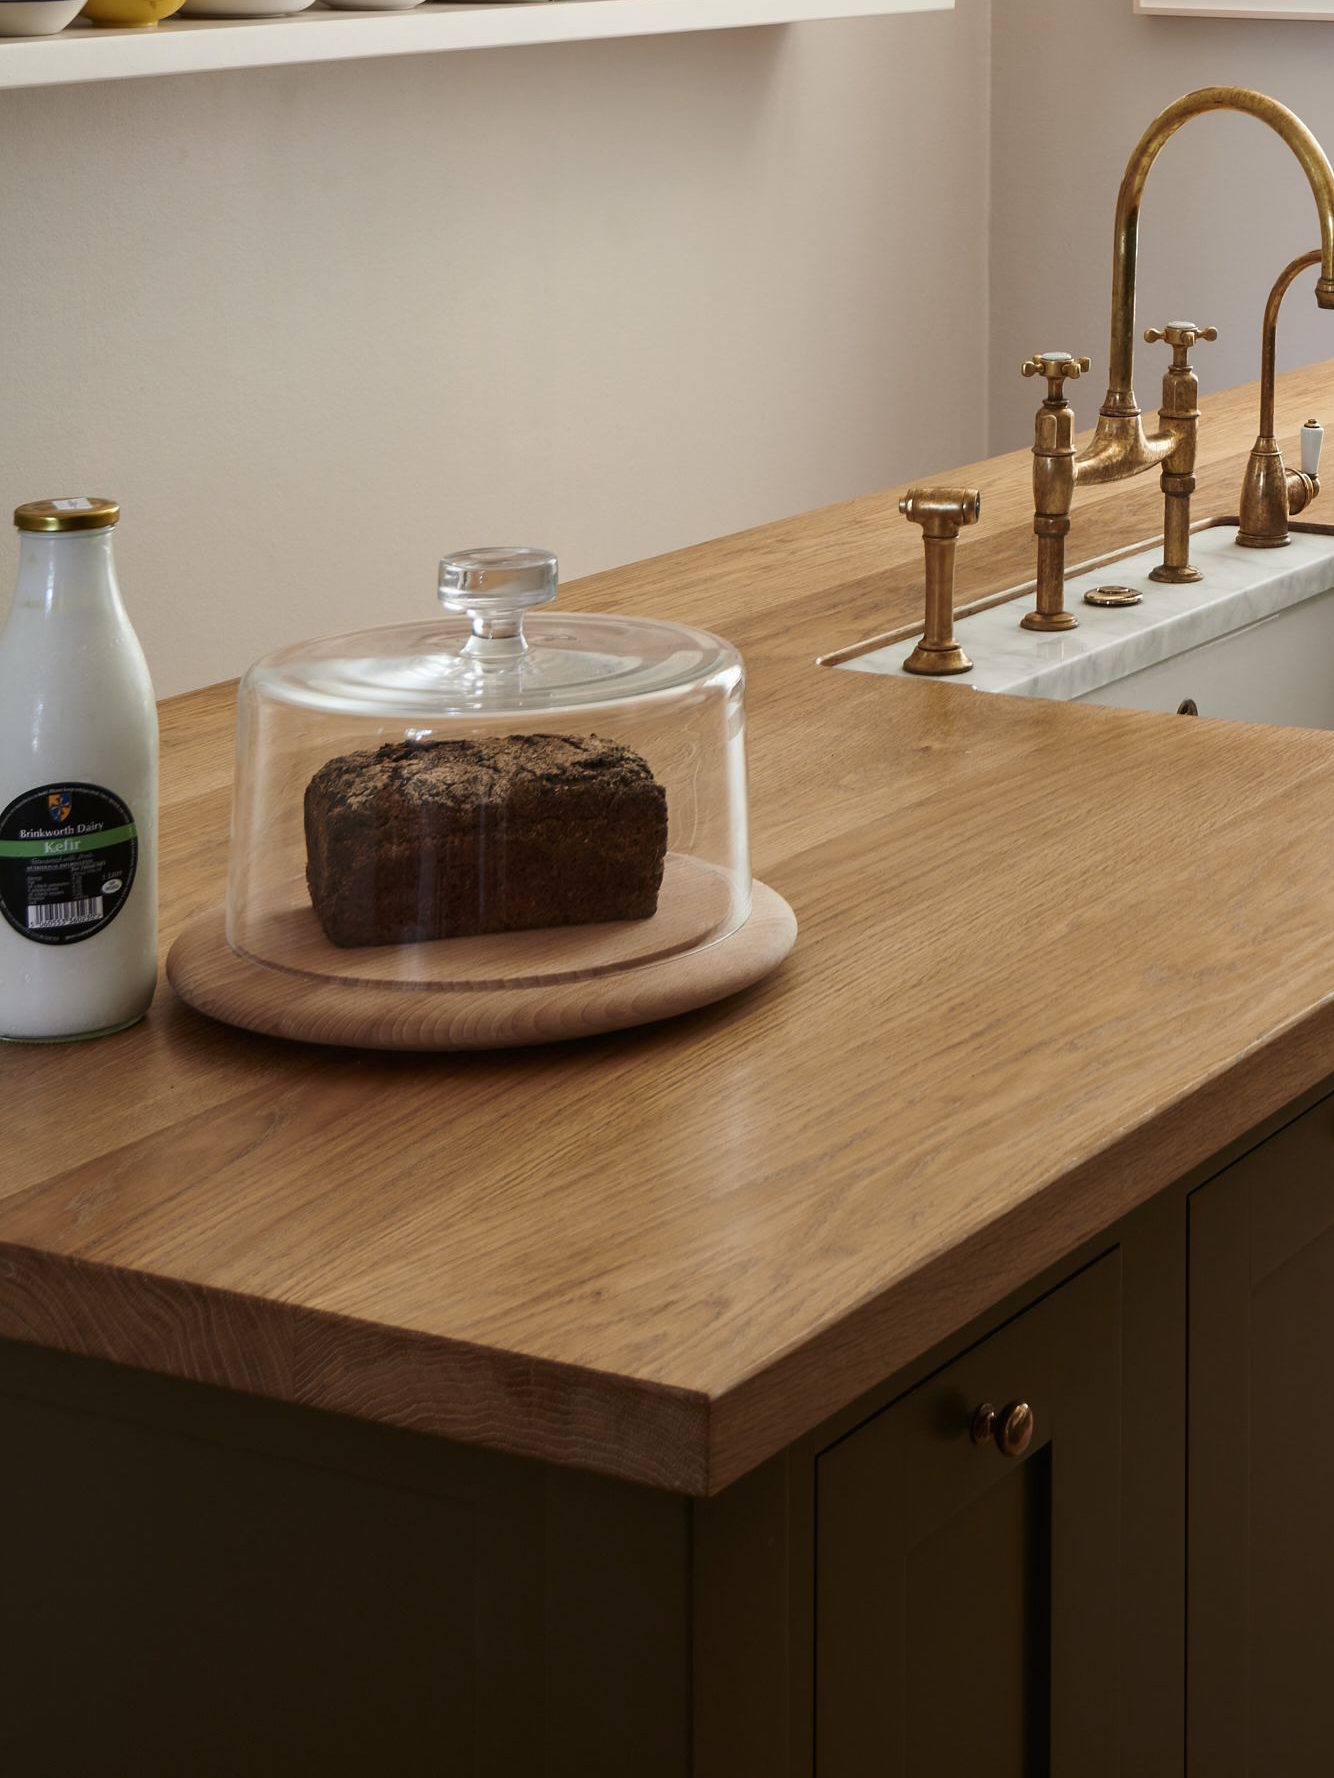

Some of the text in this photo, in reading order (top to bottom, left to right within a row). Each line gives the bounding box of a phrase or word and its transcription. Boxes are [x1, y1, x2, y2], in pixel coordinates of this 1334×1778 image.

[19, 822, 104, 838] Brinkworth Dairy
[44, 839, 81, 854] Kefir
